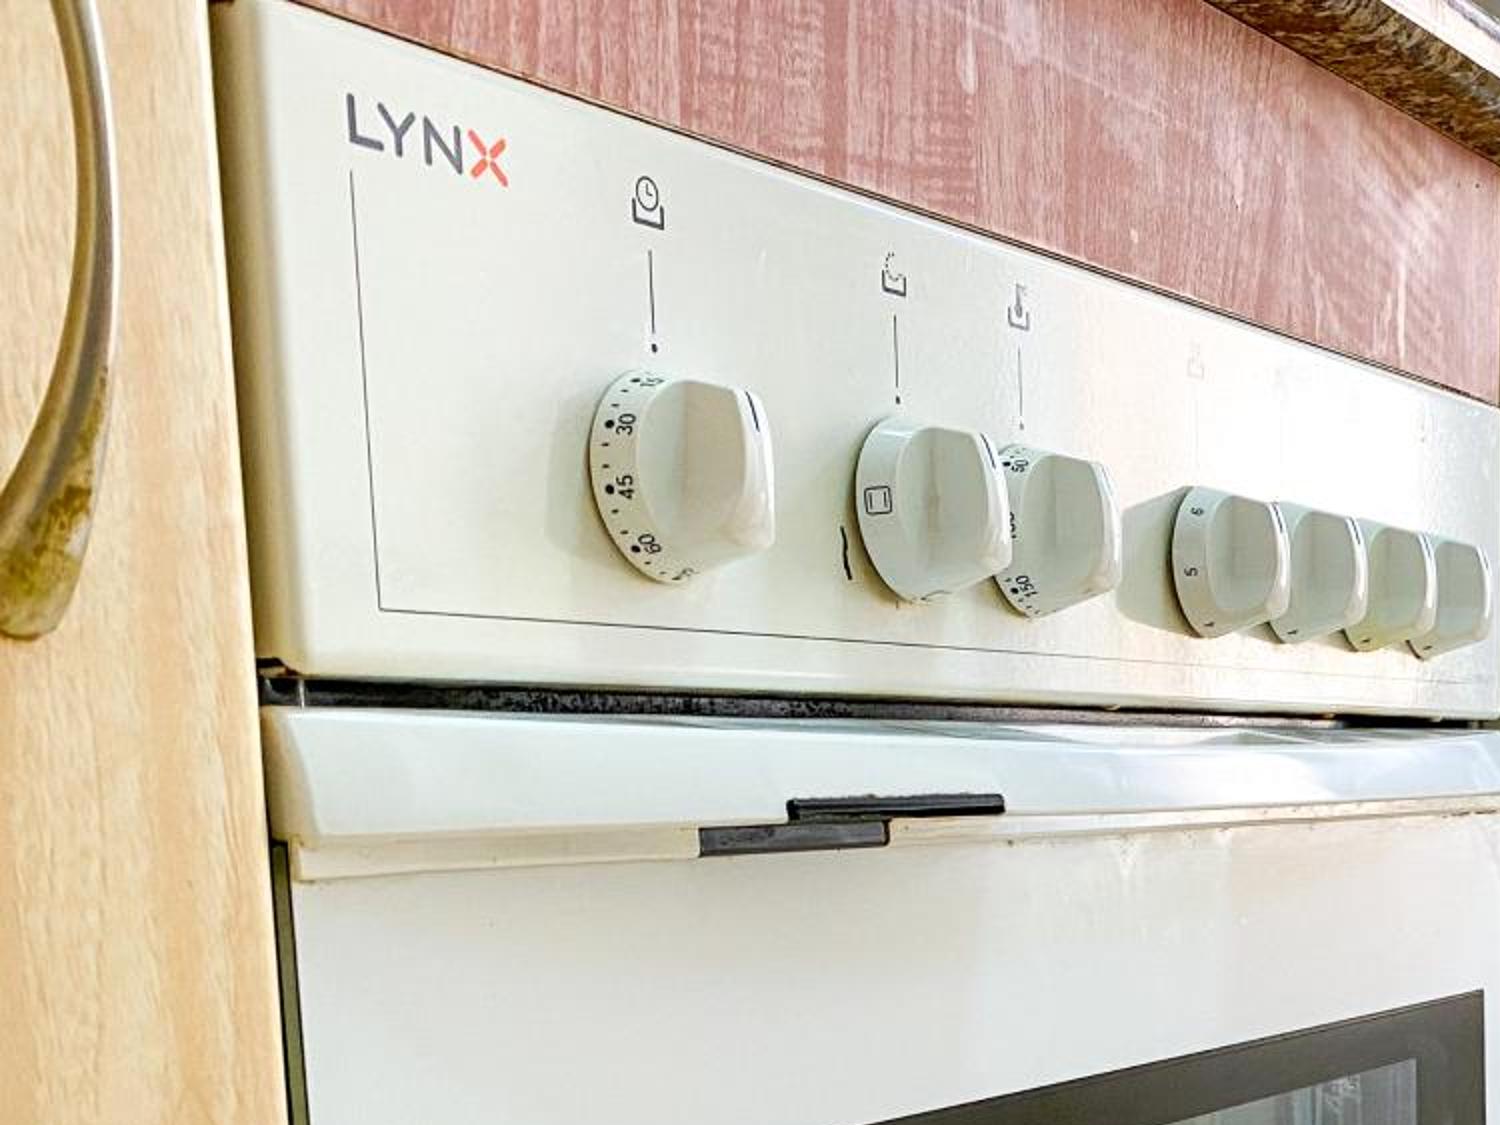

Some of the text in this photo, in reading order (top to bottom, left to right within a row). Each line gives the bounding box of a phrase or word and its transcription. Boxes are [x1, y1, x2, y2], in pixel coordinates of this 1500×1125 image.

[346, 92, 508, 187] LYNX
[616, 413, 636, 435] 30
[616, 475, 634, 500] 45
[638, 534, 661, 554] 60
[1184, 567, 1198, 577] 5
[1016, 575, 1038, 597] 150
